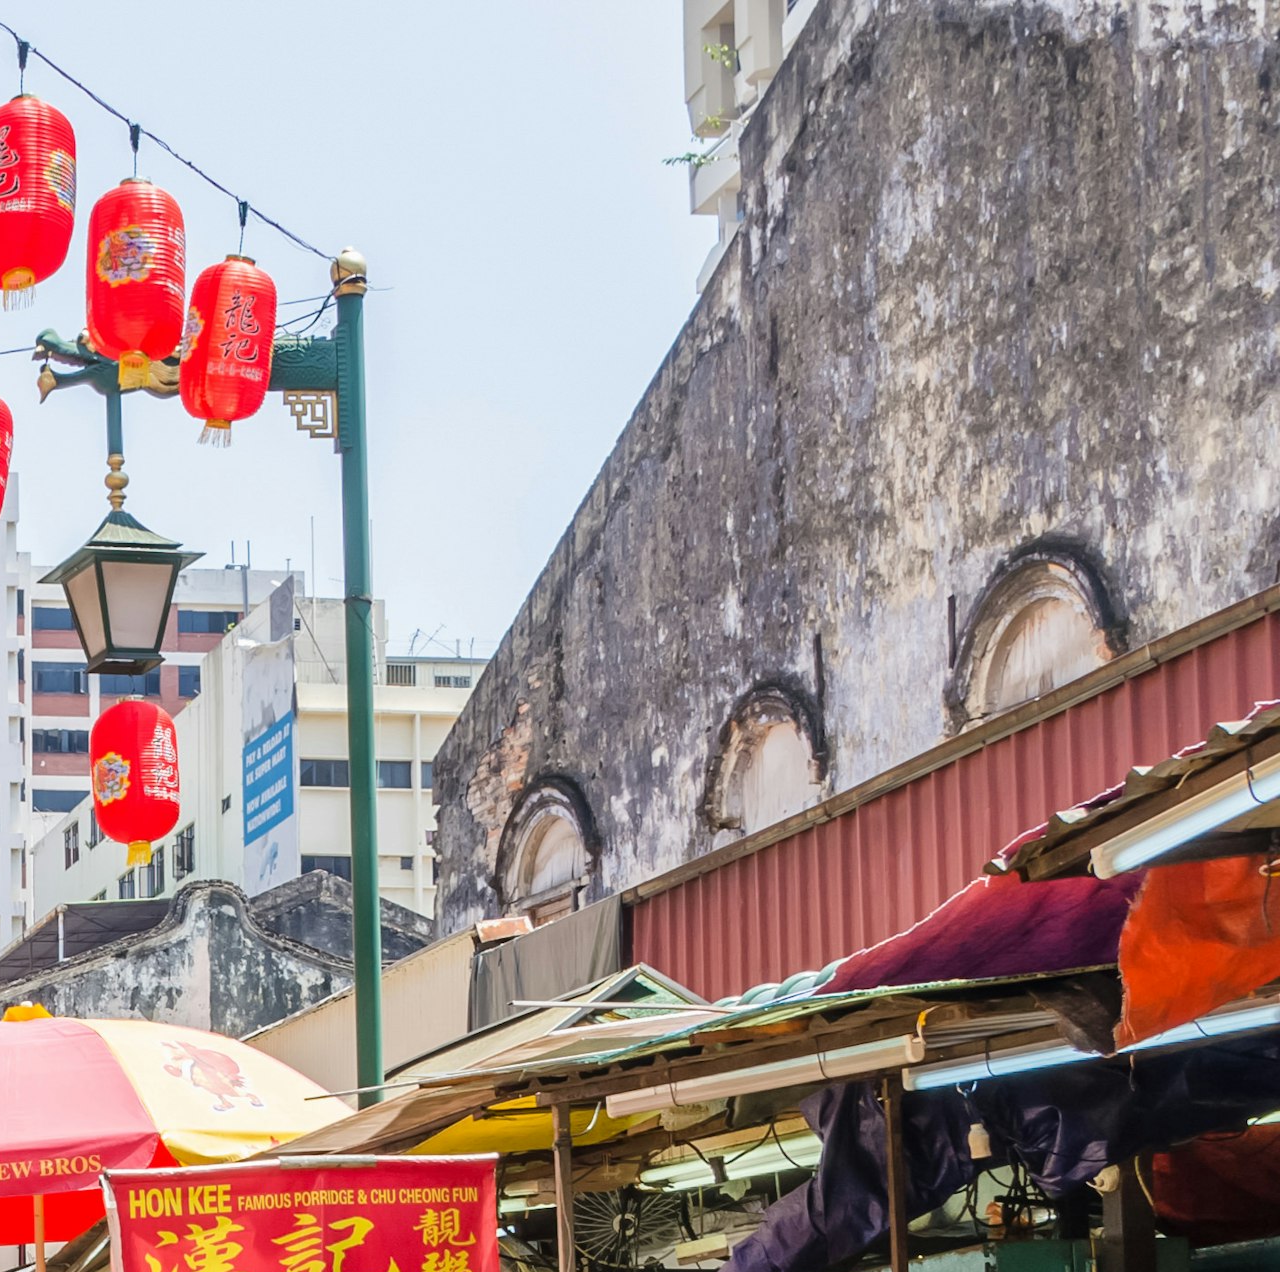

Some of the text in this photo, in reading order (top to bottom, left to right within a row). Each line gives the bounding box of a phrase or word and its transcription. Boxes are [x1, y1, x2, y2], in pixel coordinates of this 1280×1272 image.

[39, 1154, 108, 1177] BROS.
[129, 1184, 478, 1219] HON KEE FAMOUS PORRIDGE & CHU CHEONG FUN
